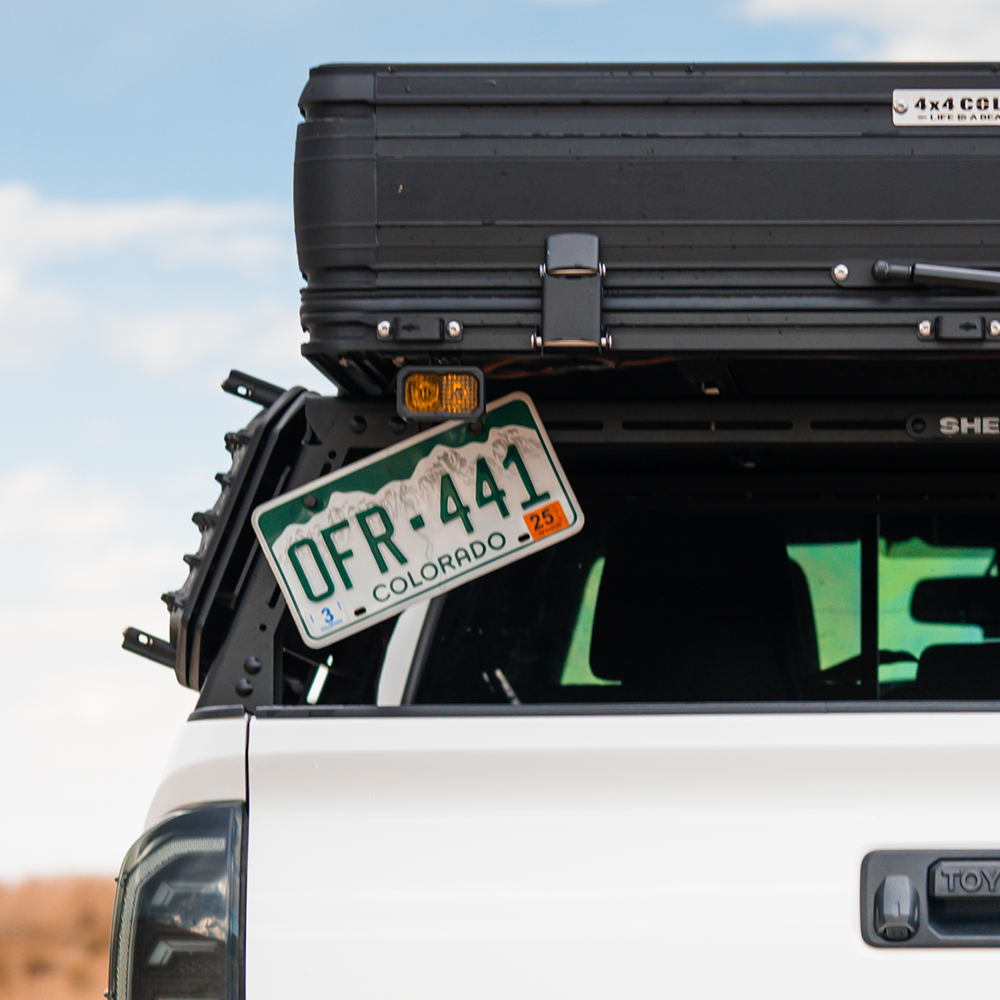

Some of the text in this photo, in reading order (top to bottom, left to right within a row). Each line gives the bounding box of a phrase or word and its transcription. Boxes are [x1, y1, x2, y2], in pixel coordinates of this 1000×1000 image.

[914, 97, 954, 111] 4x4
[529, 507, 554, 531] 25
[372, 532, 507, 602] COLORADO
[320, 606, 335, 624] 3
